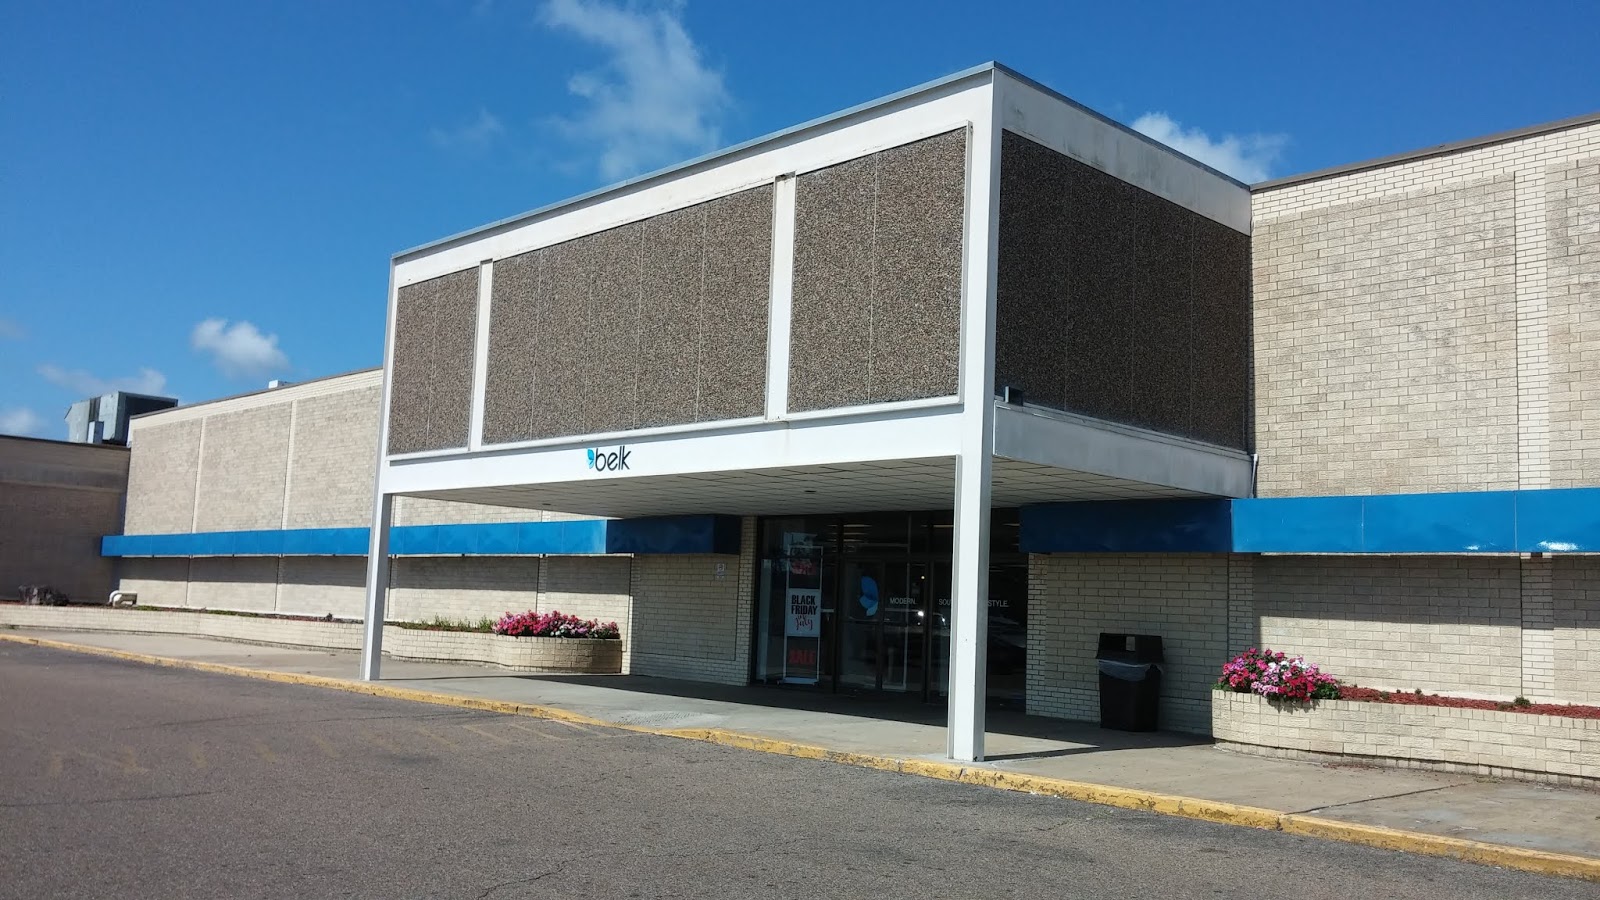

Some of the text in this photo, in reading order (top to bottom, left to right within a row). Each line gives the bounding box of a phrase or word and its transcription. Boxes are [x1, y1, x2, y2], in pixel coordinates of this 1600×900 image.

[595, 445, 632, 472] belk
[791, 594, 816, 605] BLACK
[938, 598, 952, 606] SOU
[791, 604, 818, 615] FRIDAY
